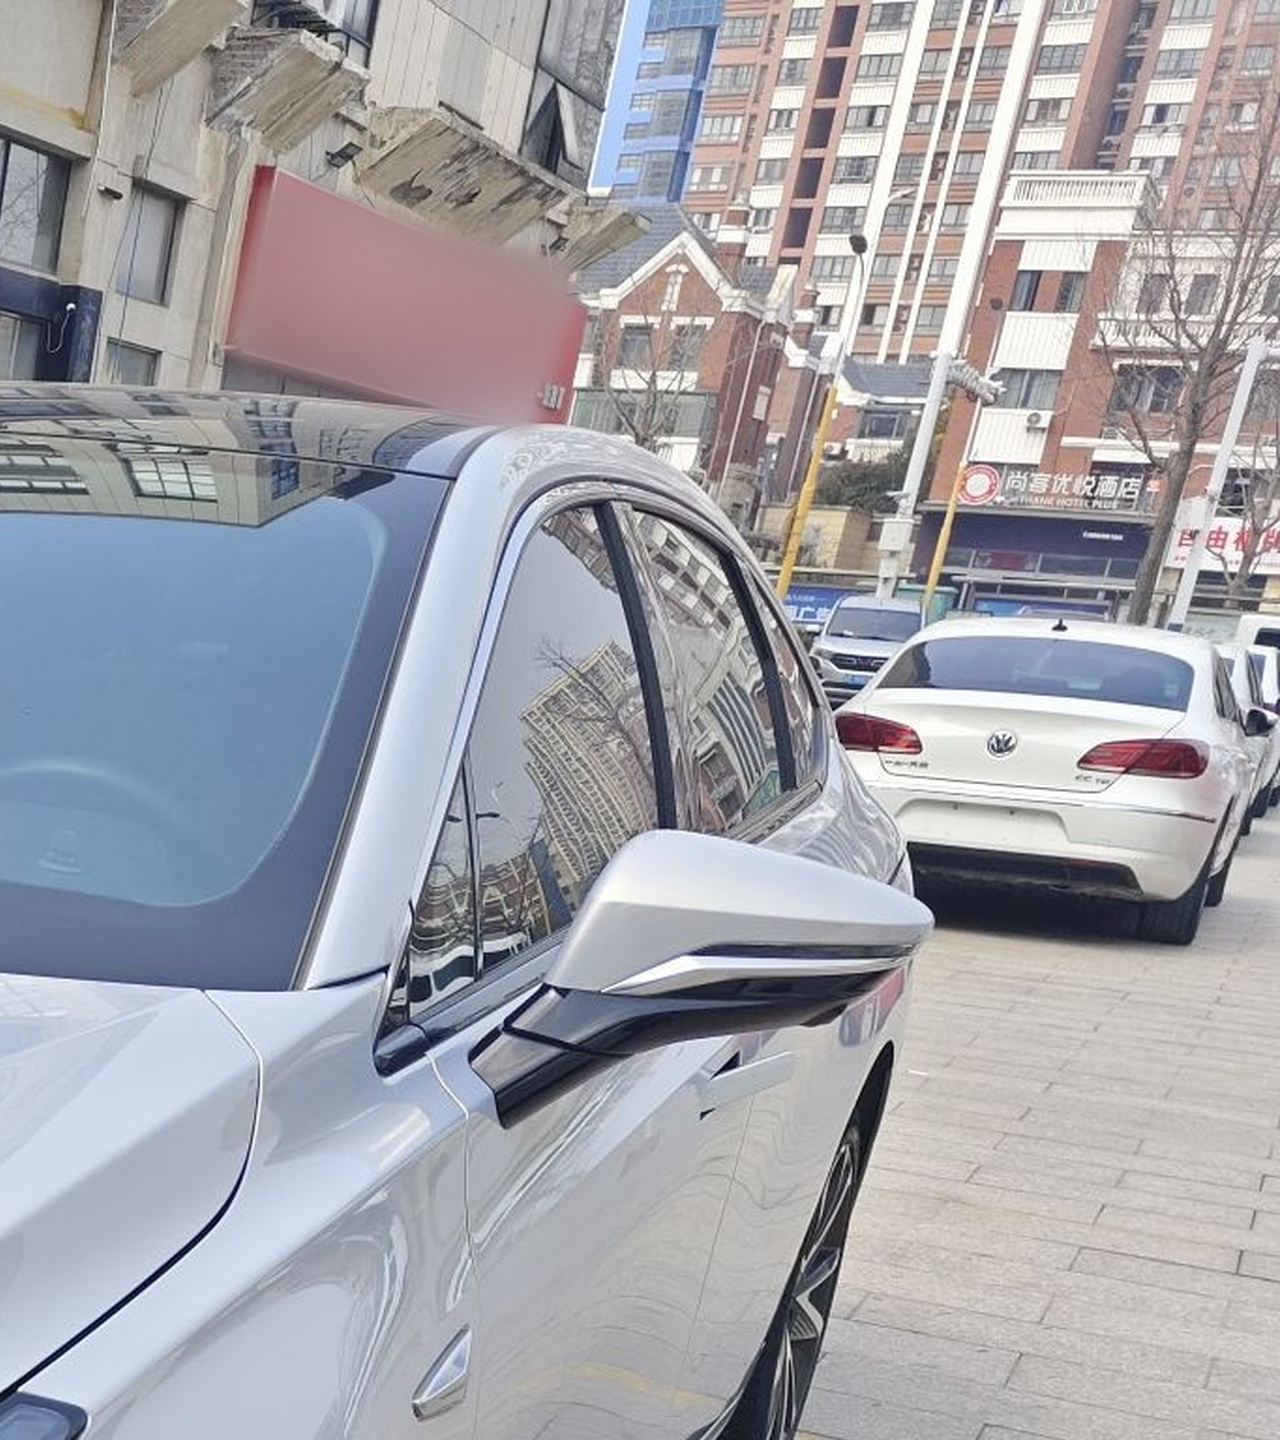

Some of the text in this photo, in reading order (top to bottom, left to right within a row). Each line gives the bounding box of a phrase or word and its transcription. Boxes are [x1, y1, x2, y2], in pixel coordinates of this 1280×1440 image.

[1004, 470, 1144, 499] 尚客优悦酒店
[1056, 498, 1090, 508] HOTEL
[1091, 499, 1119, 510] PLUS
